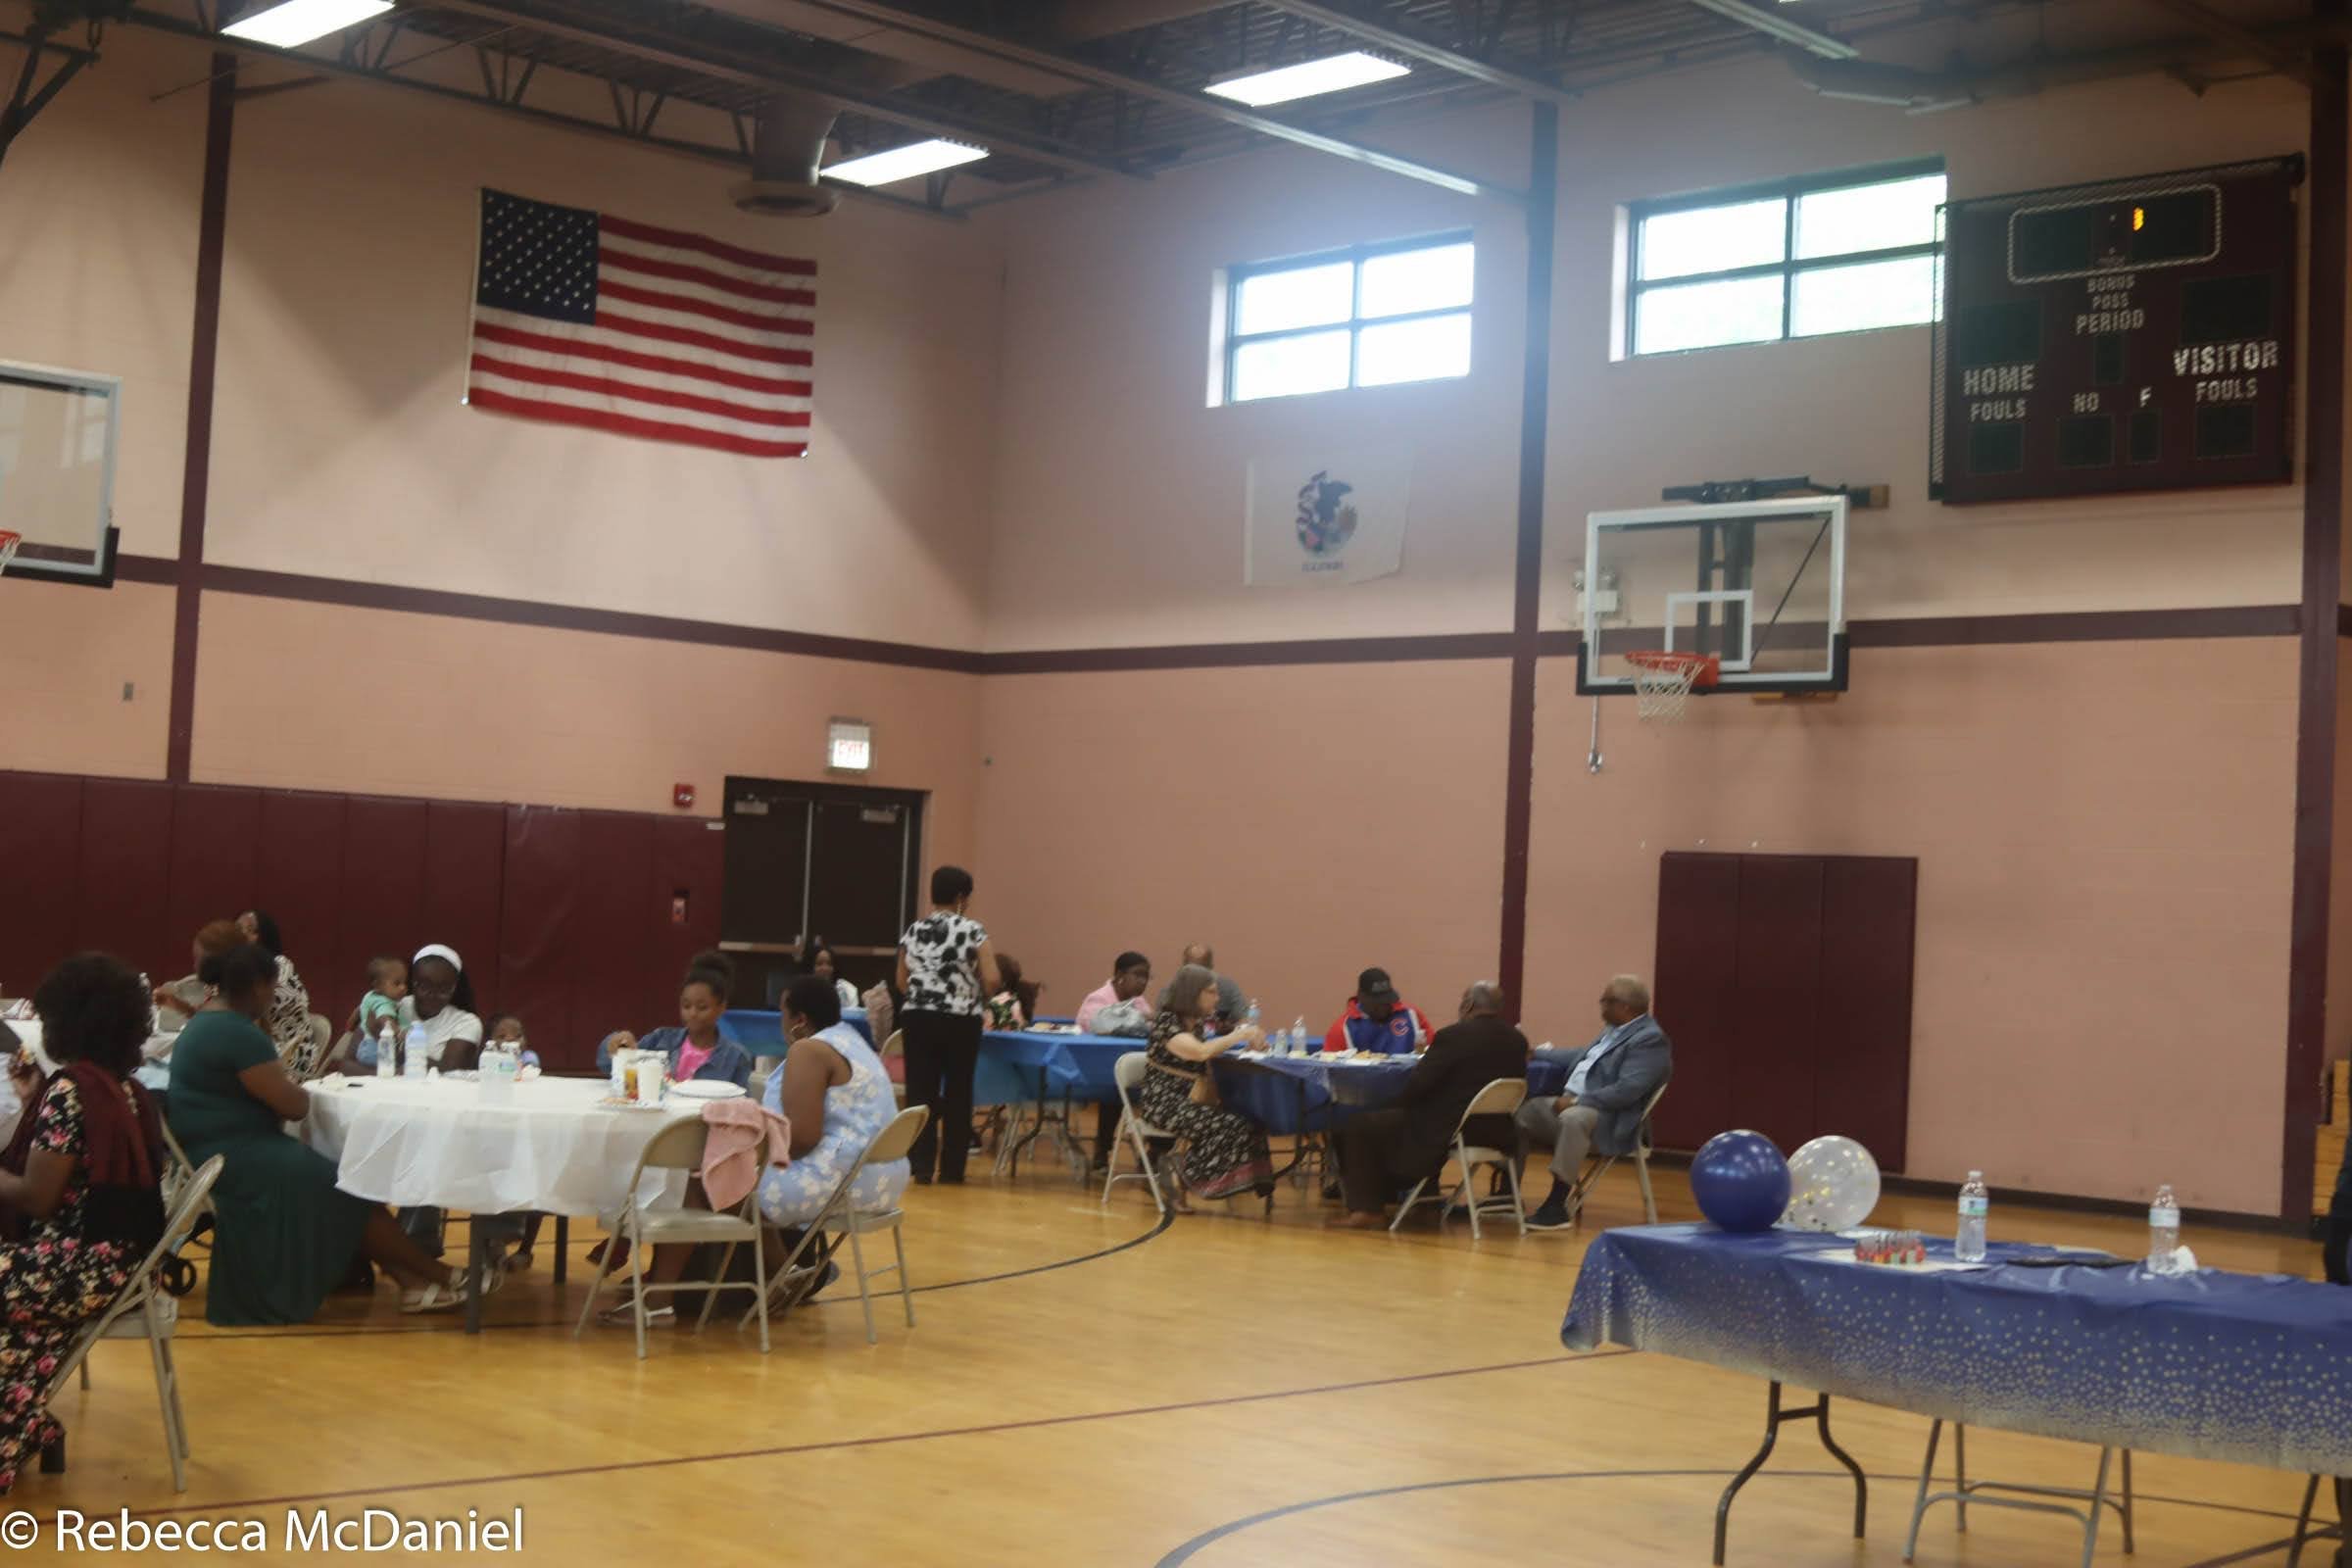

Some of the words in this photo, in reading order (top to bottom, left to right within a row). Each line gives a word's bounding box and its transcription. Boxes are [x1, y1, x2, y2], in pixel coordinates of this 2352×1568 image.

[2087, 275, 2134, 292] BONUS
[2076, 309, 2144, 334] PERIOD
[2174, 342, 2278, 375] VISITOR
[1963, 365, 2035, 396] HOME
[2195, 378, 2258, 403] FOULS
[2139, 387, 2152, 408] F
[1970, 399, 2026, 422] FOULS
[1391, 1018, 1409, 1036] C
